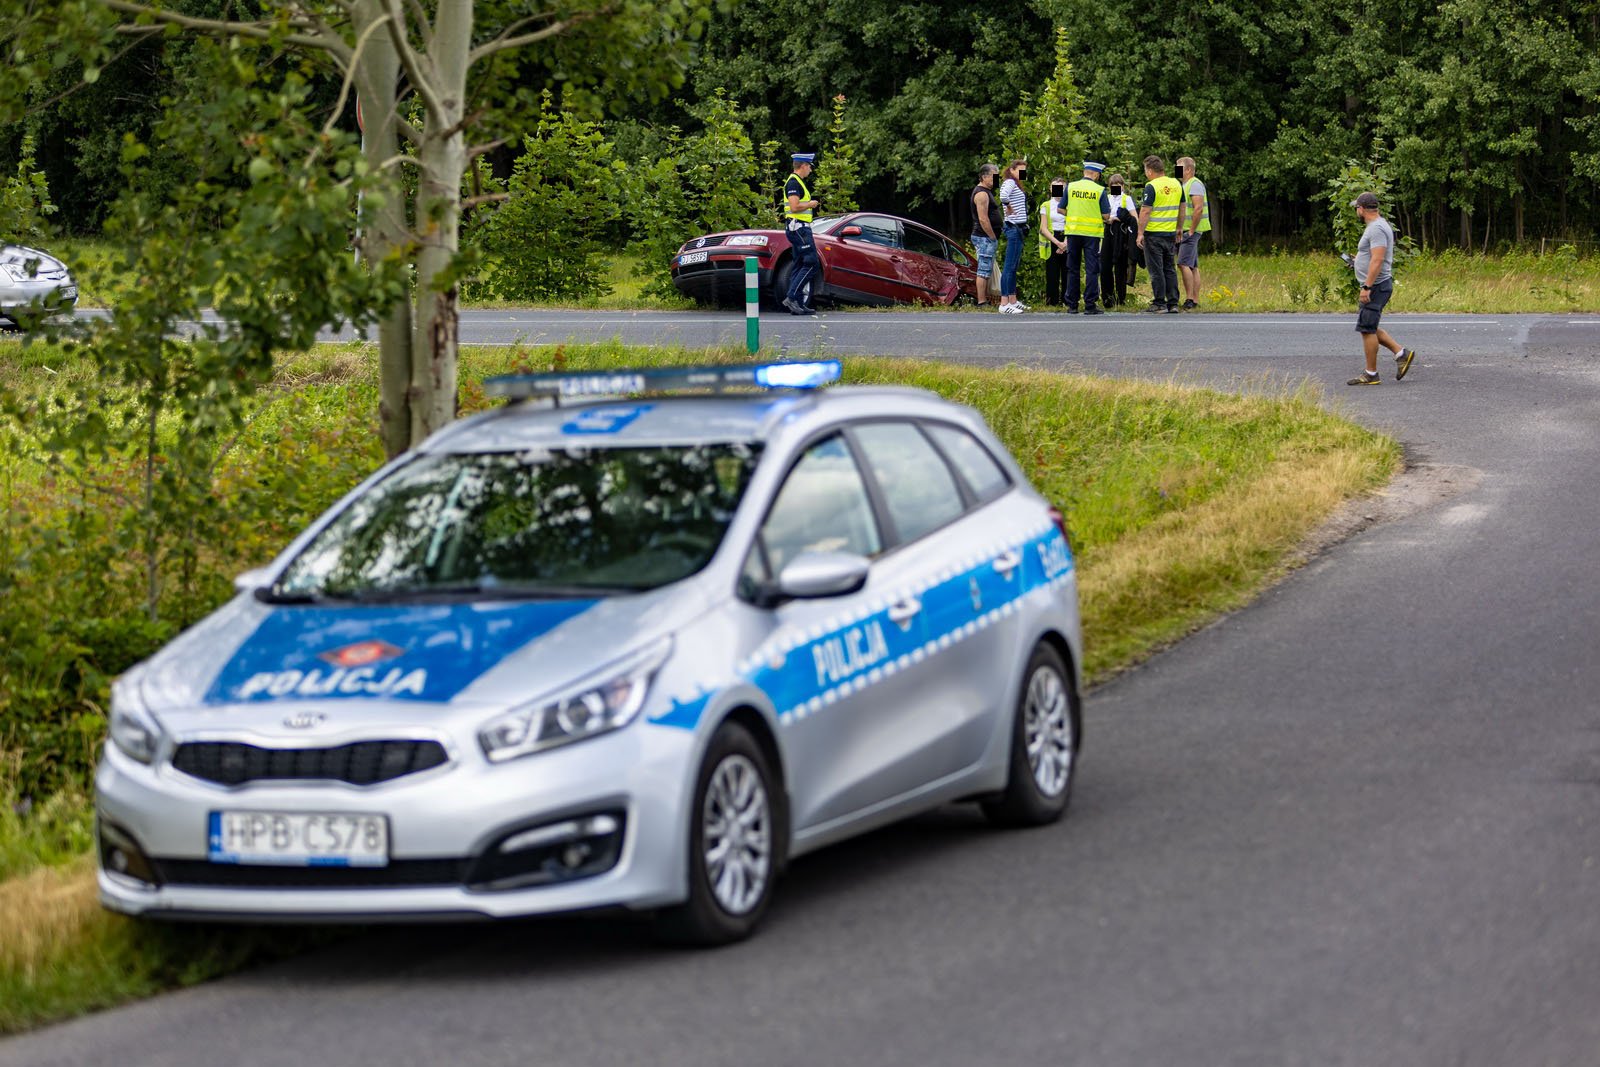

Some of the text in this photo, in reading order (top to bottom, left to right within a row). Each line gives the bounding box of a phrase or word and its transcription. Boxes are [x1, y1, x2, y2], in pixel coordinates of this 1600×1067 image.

[1071, 190, 1097, 200] POLICJA
[812, 620, 889, 687] POLICJA
[239, 668, 427, 698] POLICJA
[227, 813, 383, 852] HPB C578
